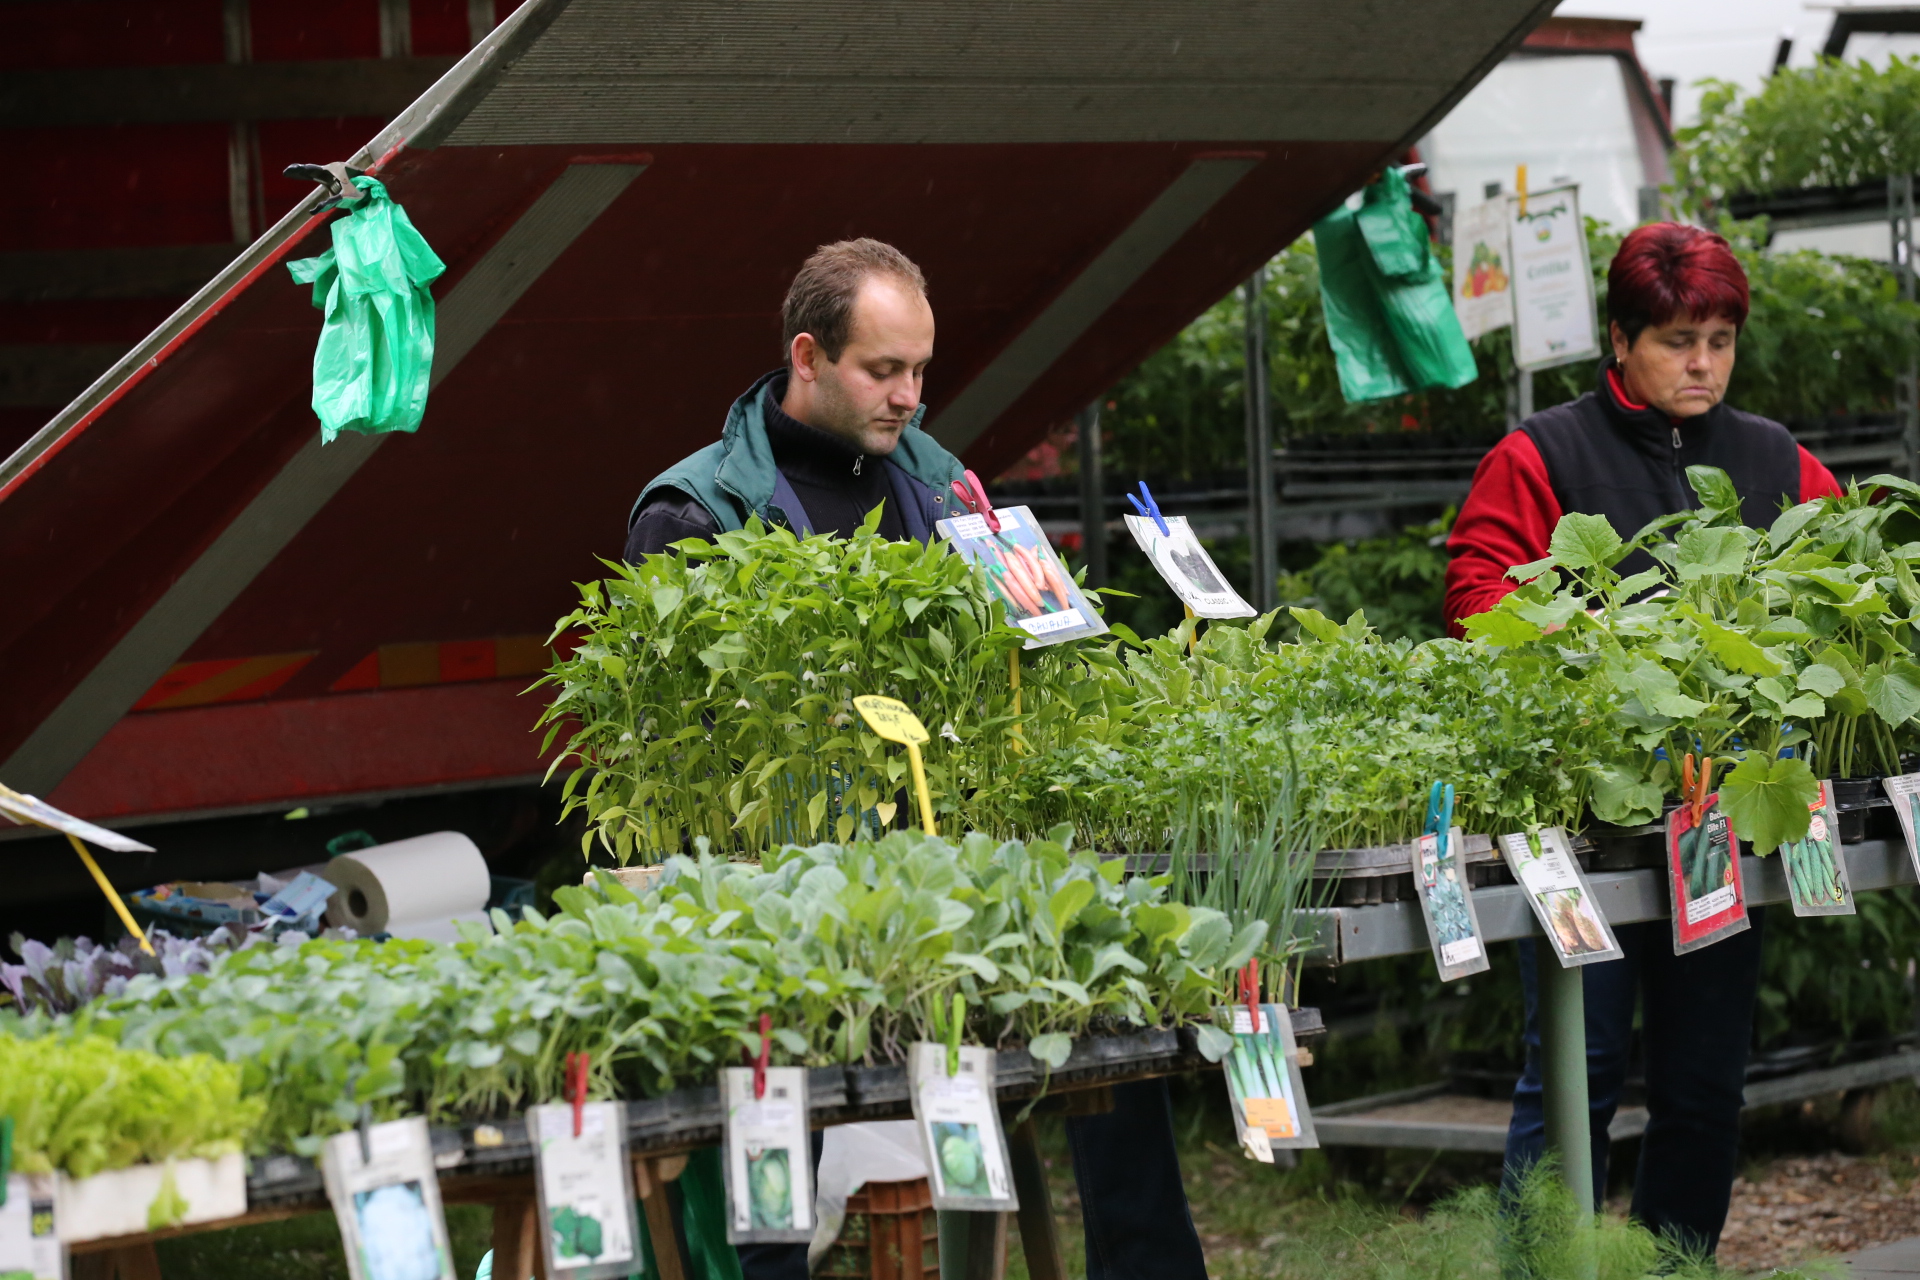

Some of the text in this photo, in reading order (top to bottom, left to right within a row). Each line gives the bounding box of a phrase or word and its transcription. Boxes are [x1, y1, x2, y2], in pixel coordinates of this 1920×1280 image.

[1029, 616, 1071, 632] BANANA
[1707, 819, 1726, 833] Elite F1
